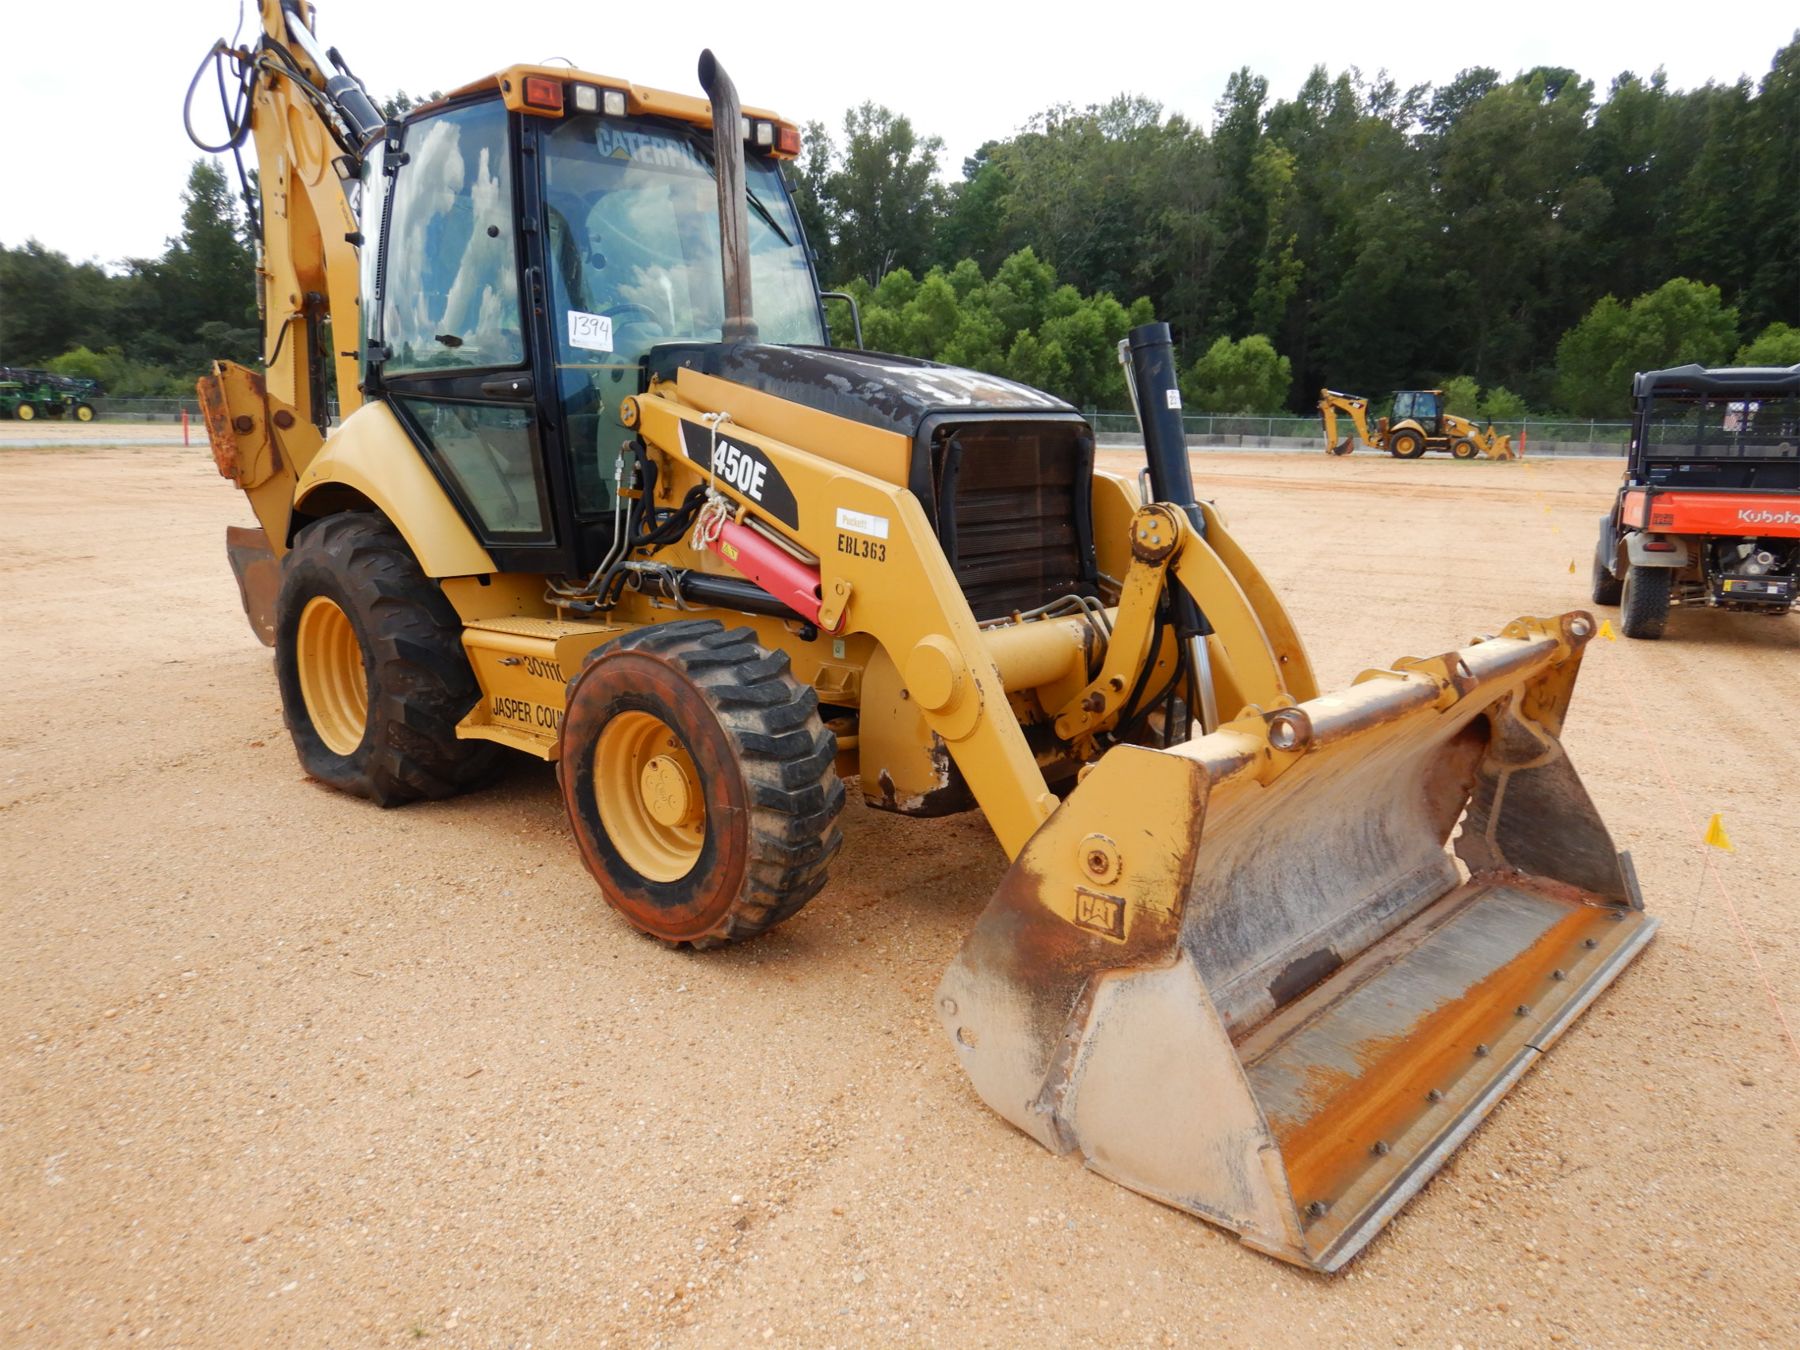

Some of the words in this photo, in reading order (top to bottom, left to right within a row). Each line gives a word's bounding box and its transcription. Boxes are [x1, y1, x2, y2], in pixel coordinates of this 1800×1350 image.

[573, 315, 609, 342] 1394
[713, 440, 767, 501] 450E
[1737, 508, 1800, 525] Kubota
[838, 534, 886, 562] EBL363
[493, 697, 532, 724] JASPER
[536, 704, 564, 730] COU
